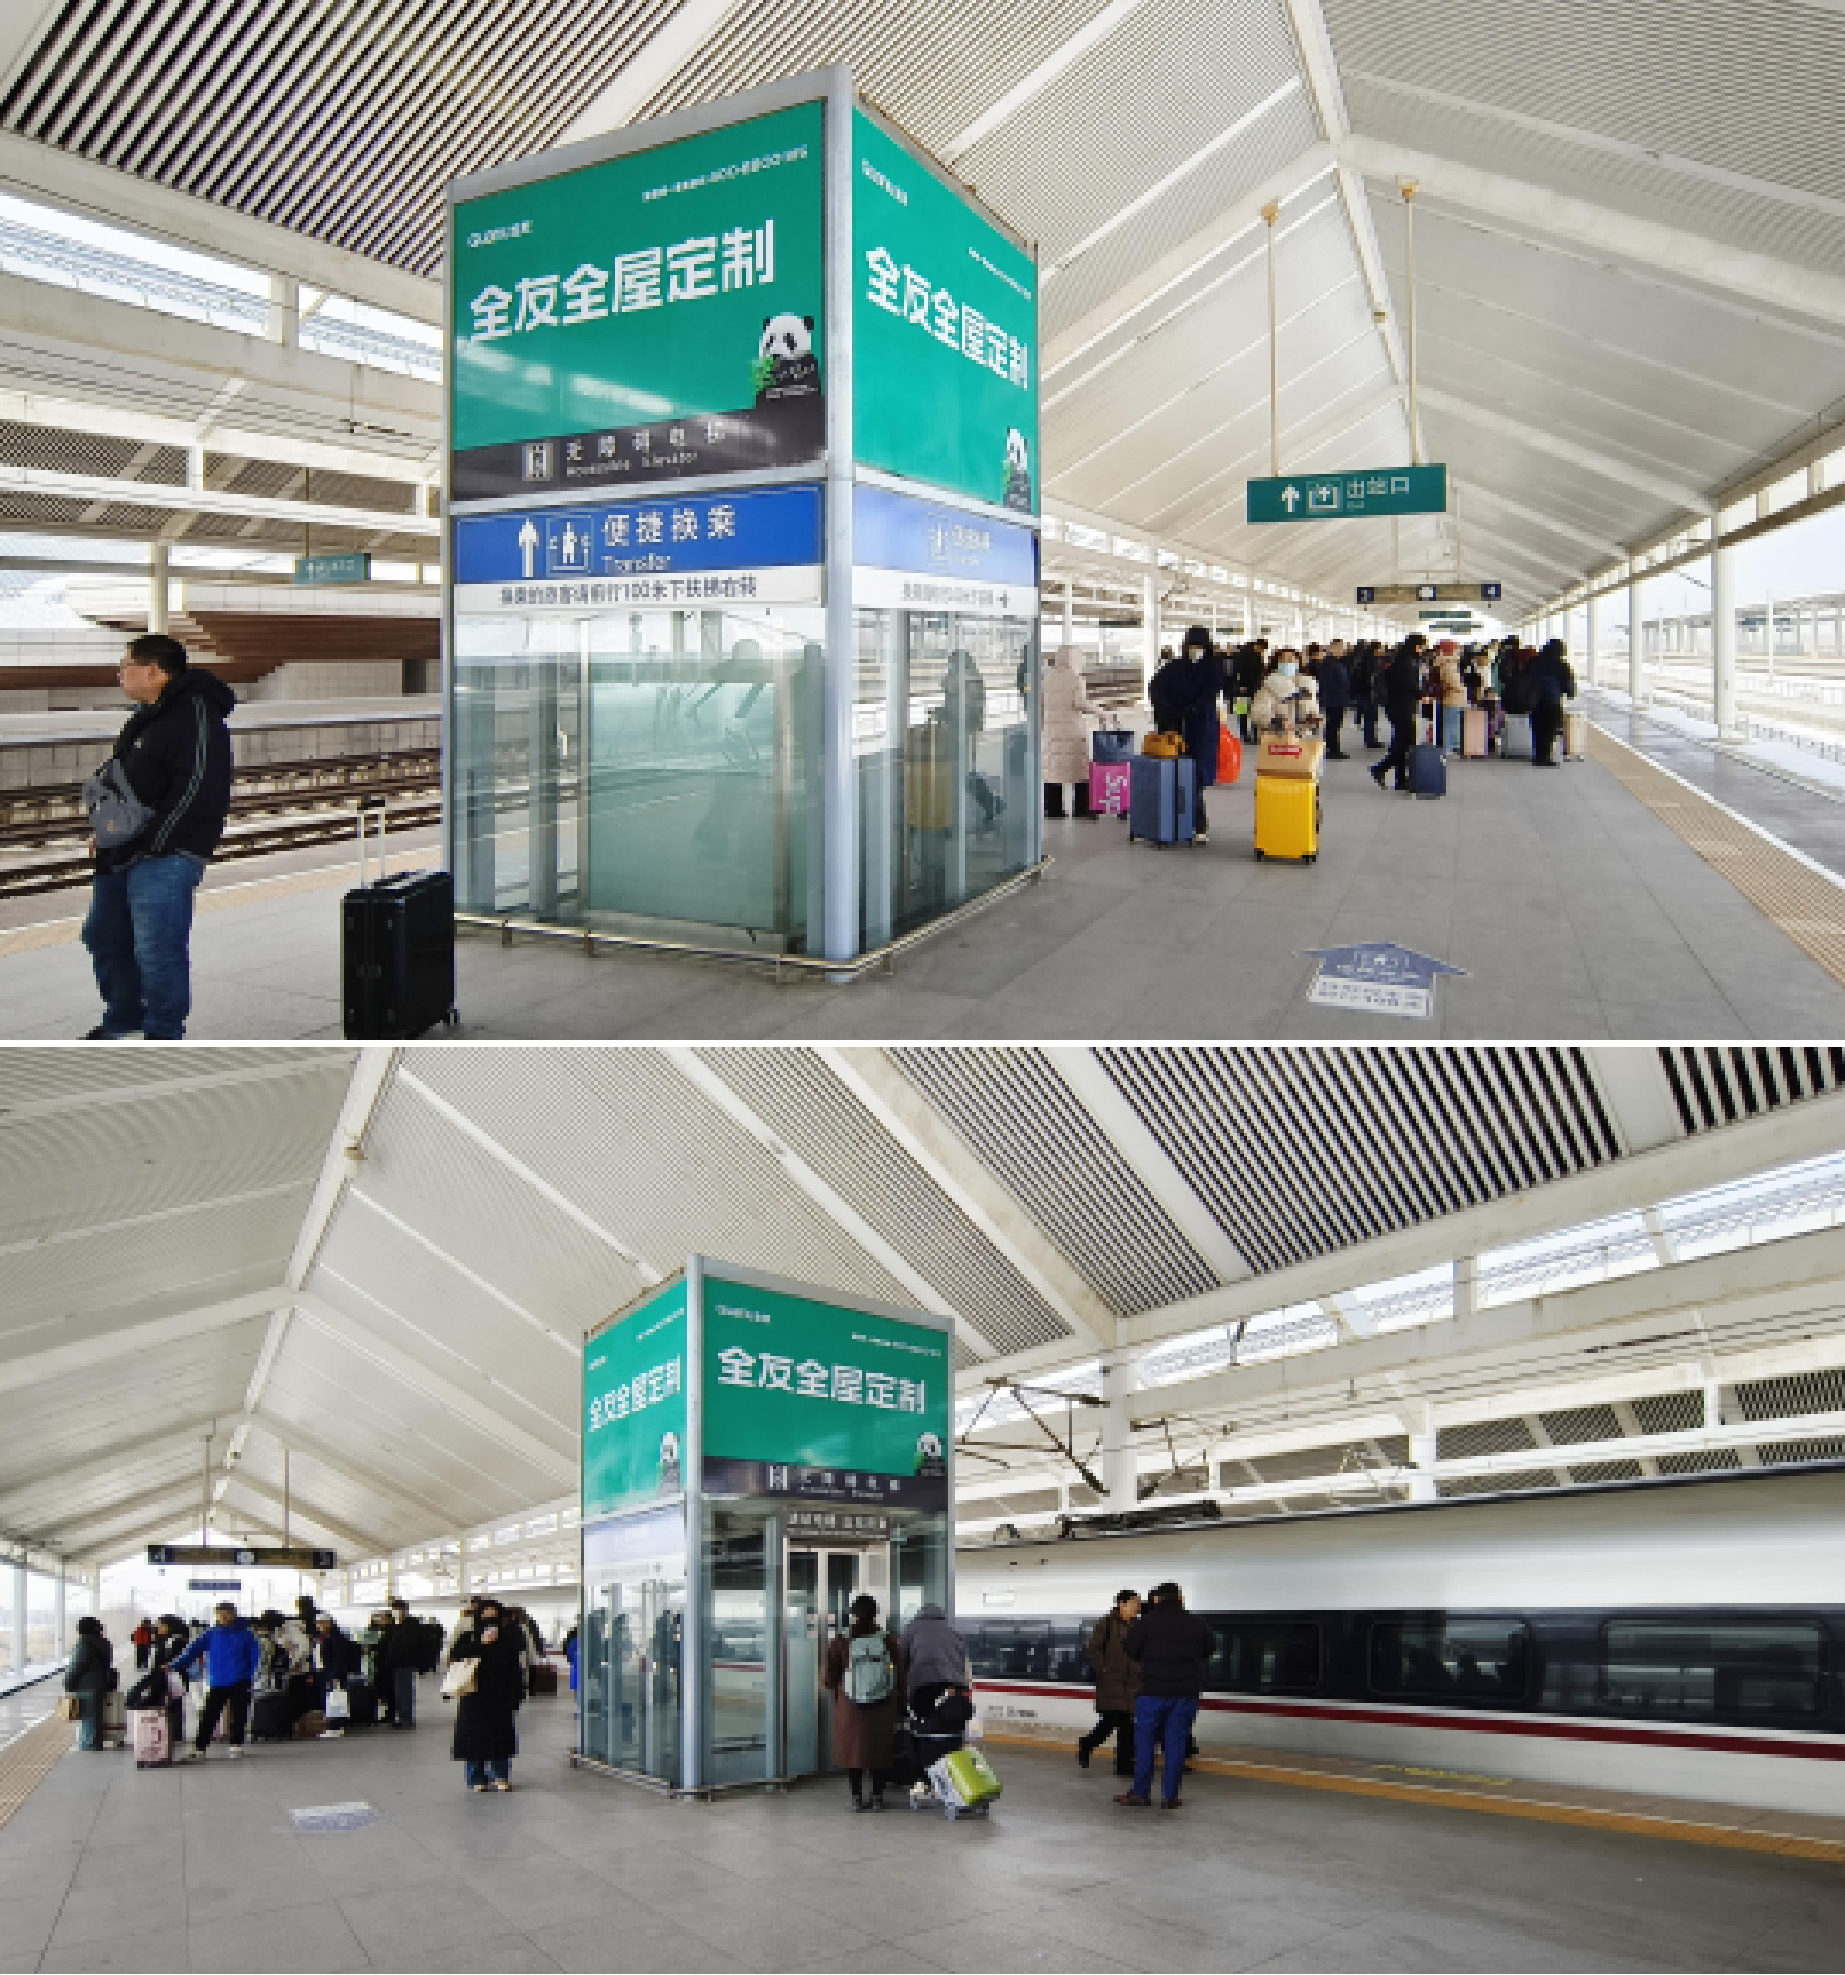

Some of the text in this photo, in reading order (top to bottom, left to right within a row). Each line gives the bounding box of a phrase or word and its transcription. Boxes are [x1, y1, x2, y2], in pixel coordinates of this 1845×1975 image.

[469, 218, 775, 343] 全友全屋定制
[865, 246, 1029, 390] 全友全屋定制
[600, 504, 736, 547] 便捷换乘
[717, 1345, 925, 1414] 全友全屋定制
